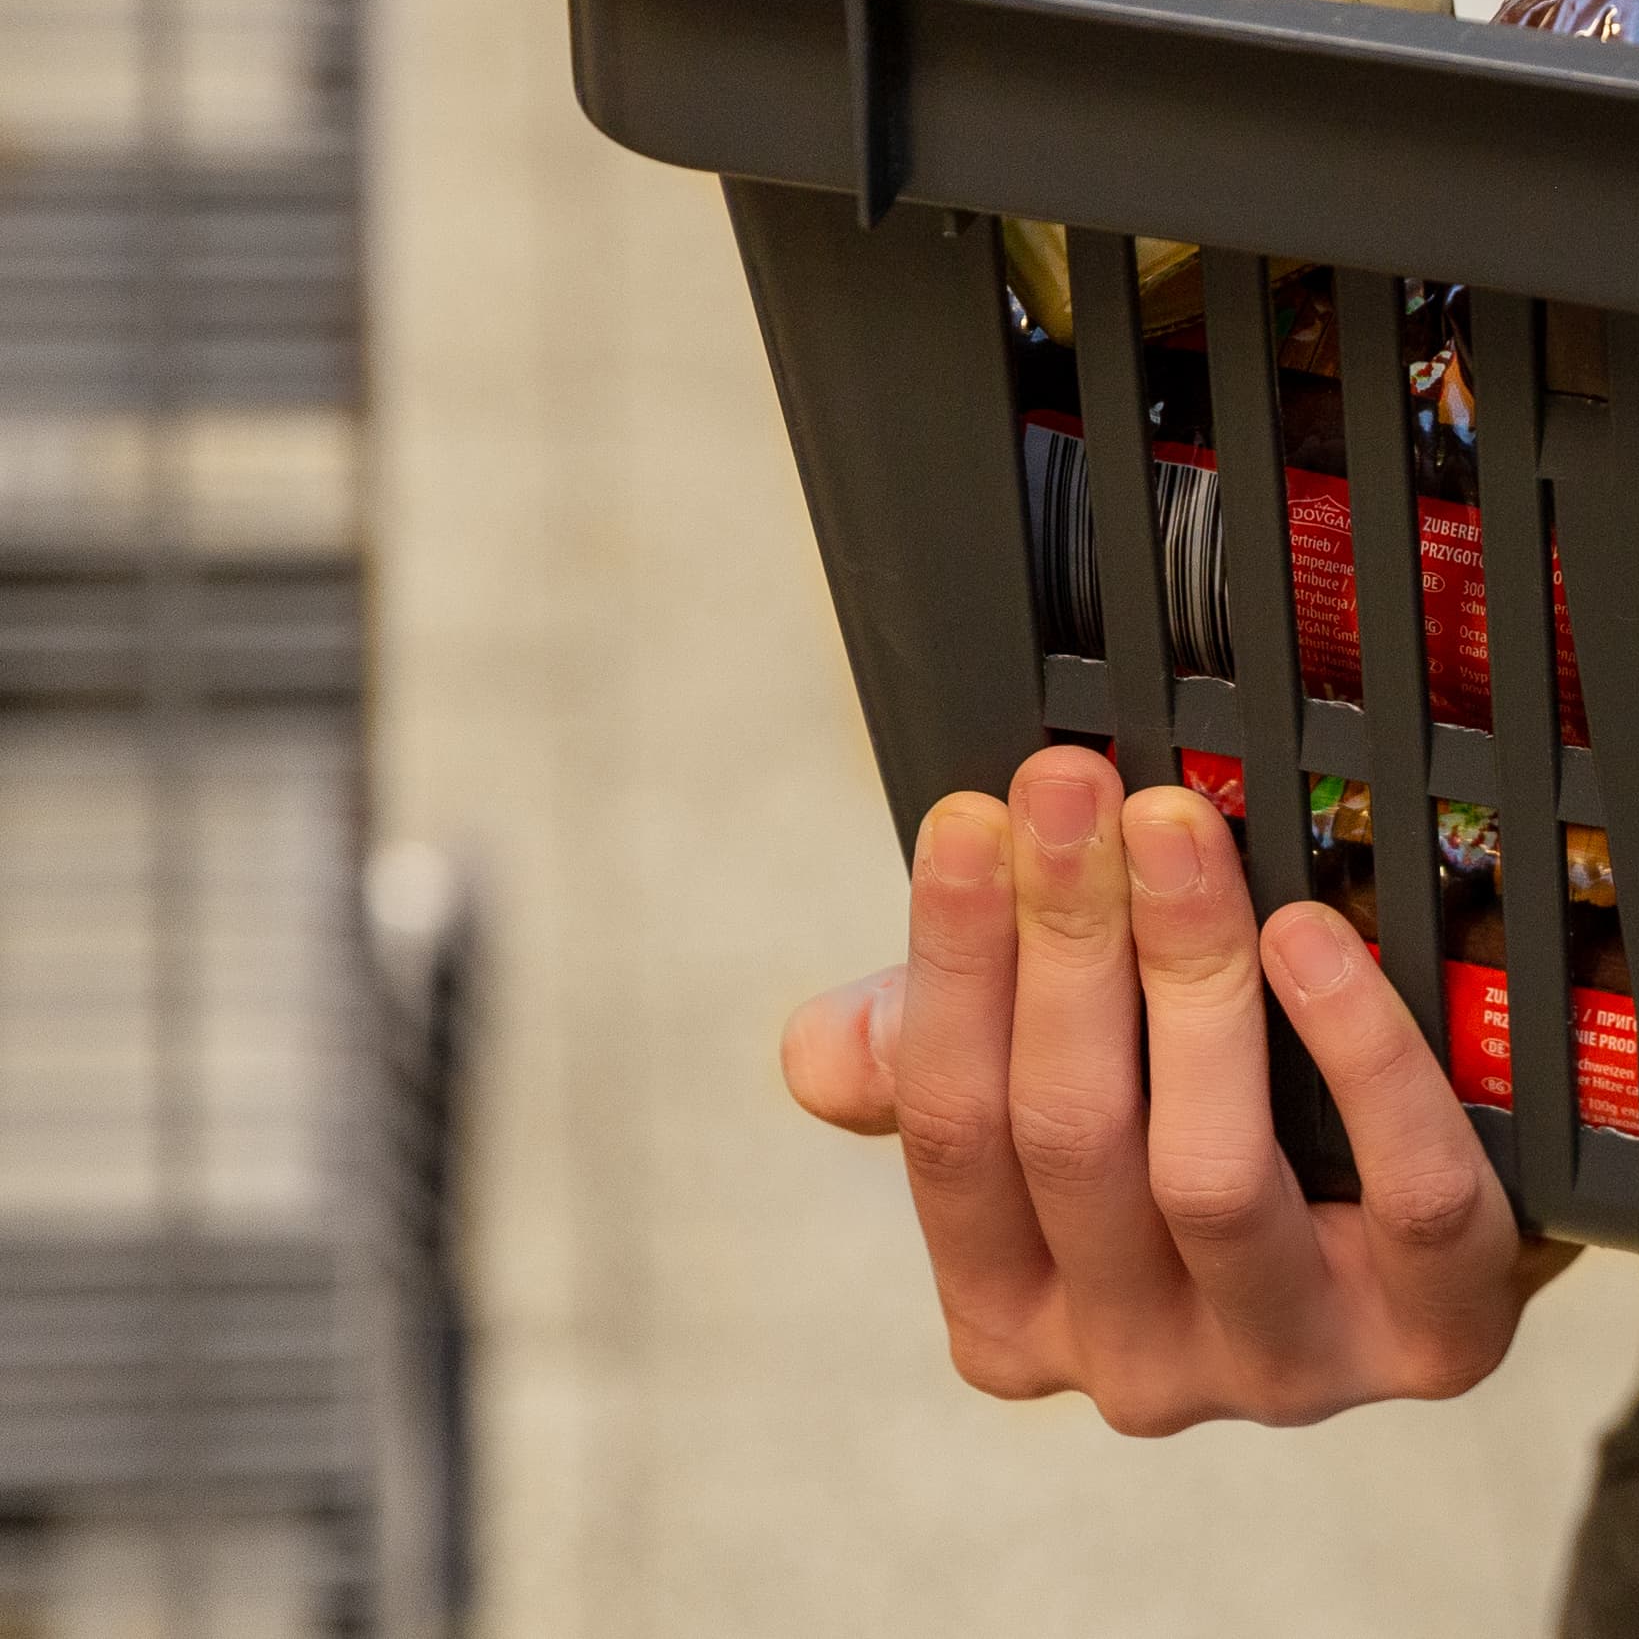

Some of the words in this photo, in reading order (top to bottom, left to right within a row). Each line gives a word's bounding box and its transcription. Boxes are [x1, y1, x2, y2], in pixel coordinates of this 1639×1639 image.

[1290, 531, 1332, 554] ertrieb
[1488, 1039, 1505, 1055] DE
[1592, 1074, 1624, 1094] Hitze
